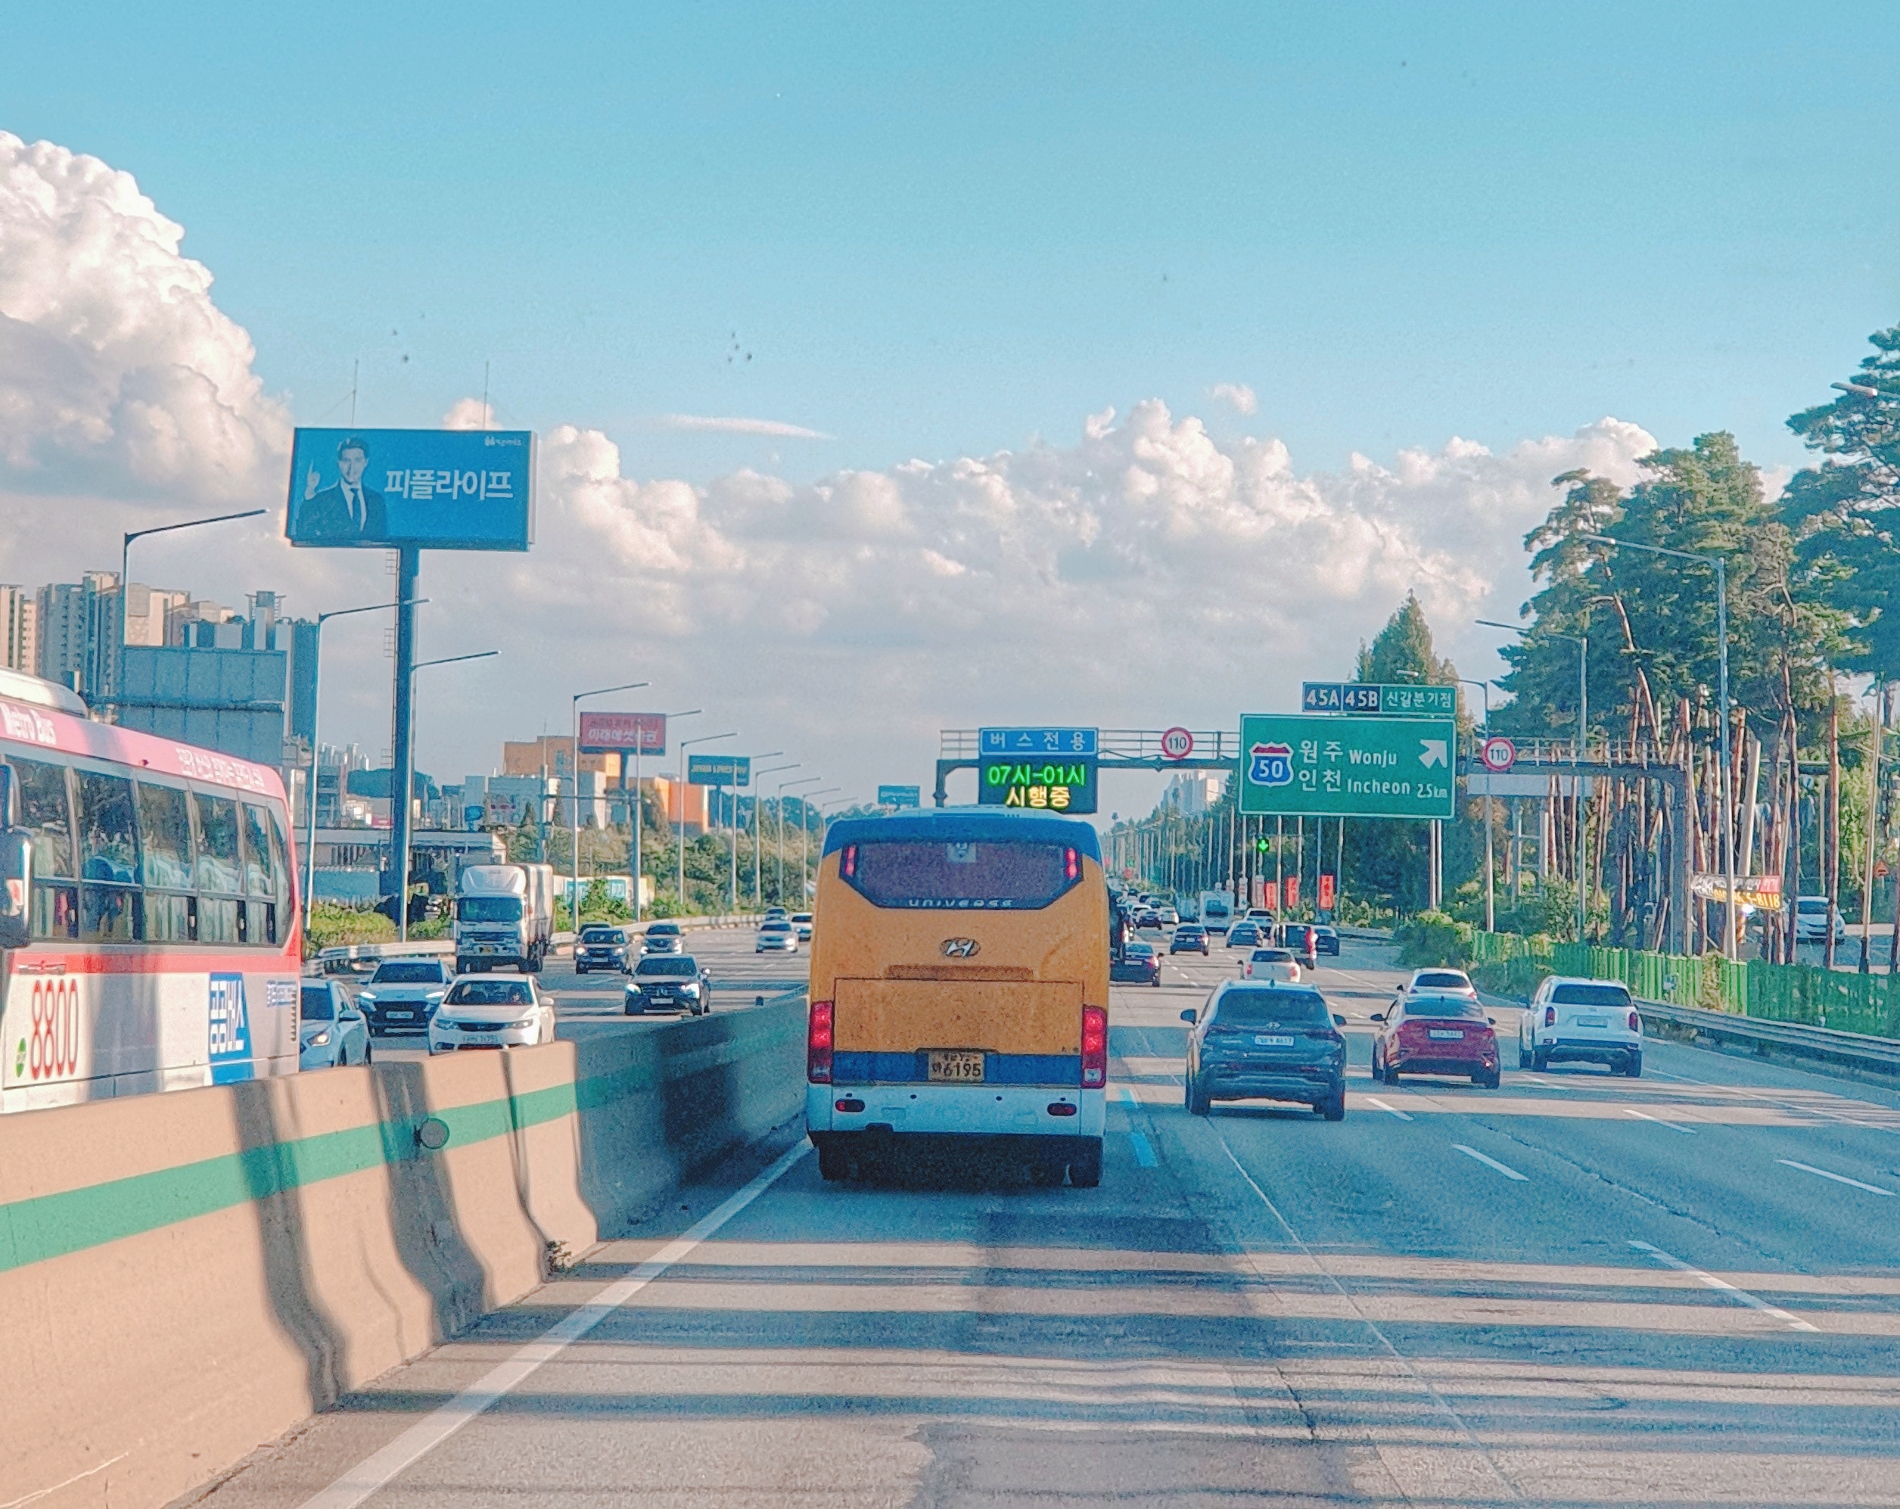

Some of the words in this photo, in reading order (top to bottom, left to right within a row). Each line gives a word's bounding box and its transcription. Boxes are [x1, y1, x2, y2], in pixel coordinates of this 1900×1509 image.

[384, 468, 514, 501] 피플라이프
[1306, 689, 1339, 707] 45A
[1345, 690, 1378, 708] 45B
[1386, 691, 1452, 709] 신갈분기점
[990, 731, 1086, 752] 버스전용
[1168, 737, 1187, 750] 110
[1299, 740, 1344, 765] 원주
[1349, 749, 1398, 768] Wonju
[1489, 748, 1509, 762] 110
[988, 764, 1085, 786] 07시-01시
[1258, 760, 1283, 779] 50
[1298, 769, 1342, 792] 인천
[1347, 778, 1411, 795] Incheon
[1006, 786, 1070, 807] 시행중
[210, 980, 245, 1055] 공공버스
[31, 979, 79, 1080] 8800
